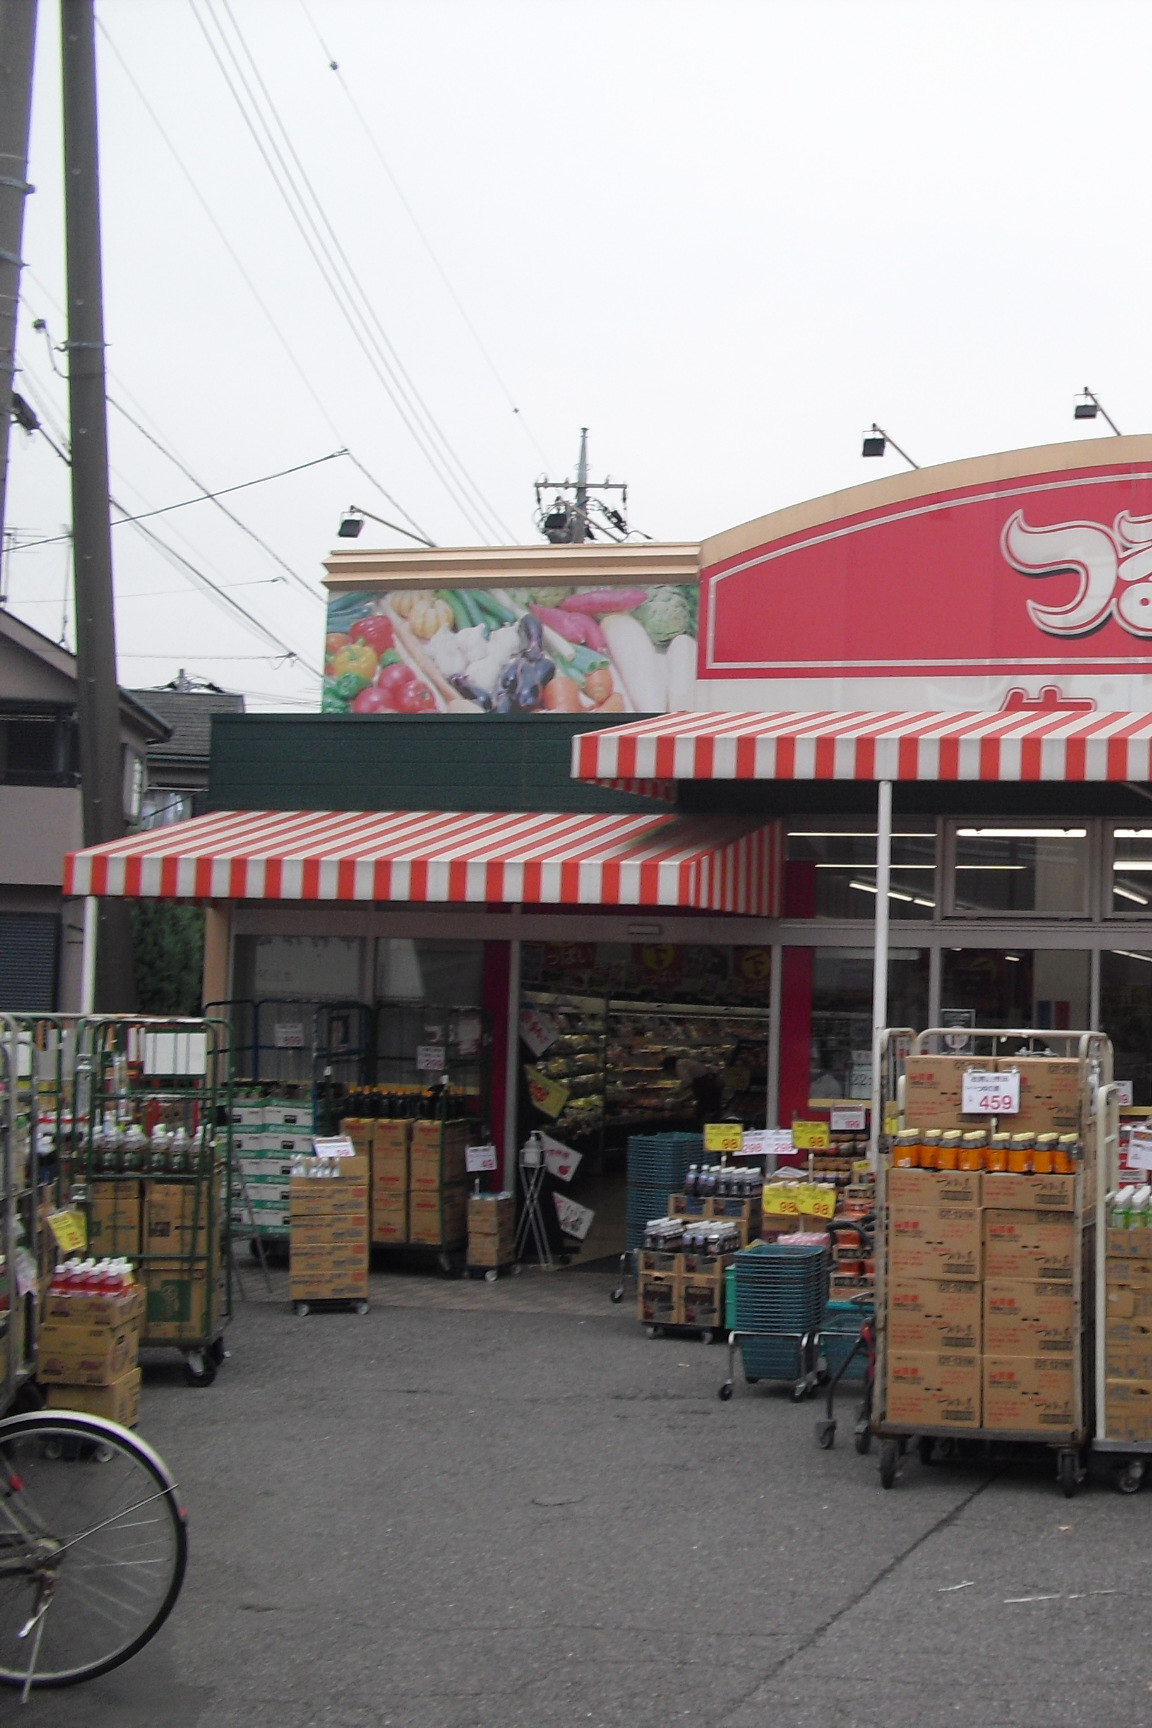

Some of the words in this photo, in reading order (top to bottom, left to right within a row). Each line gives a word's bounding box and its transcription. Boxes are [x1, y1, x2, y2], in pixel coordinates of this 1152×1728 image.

[979, 1095, 1012, 1110] 459
[722, 1139, 738, 1149] 98
[809, 1137, 824, 1147] 98
[813, 1203, 829, 1215] 98
